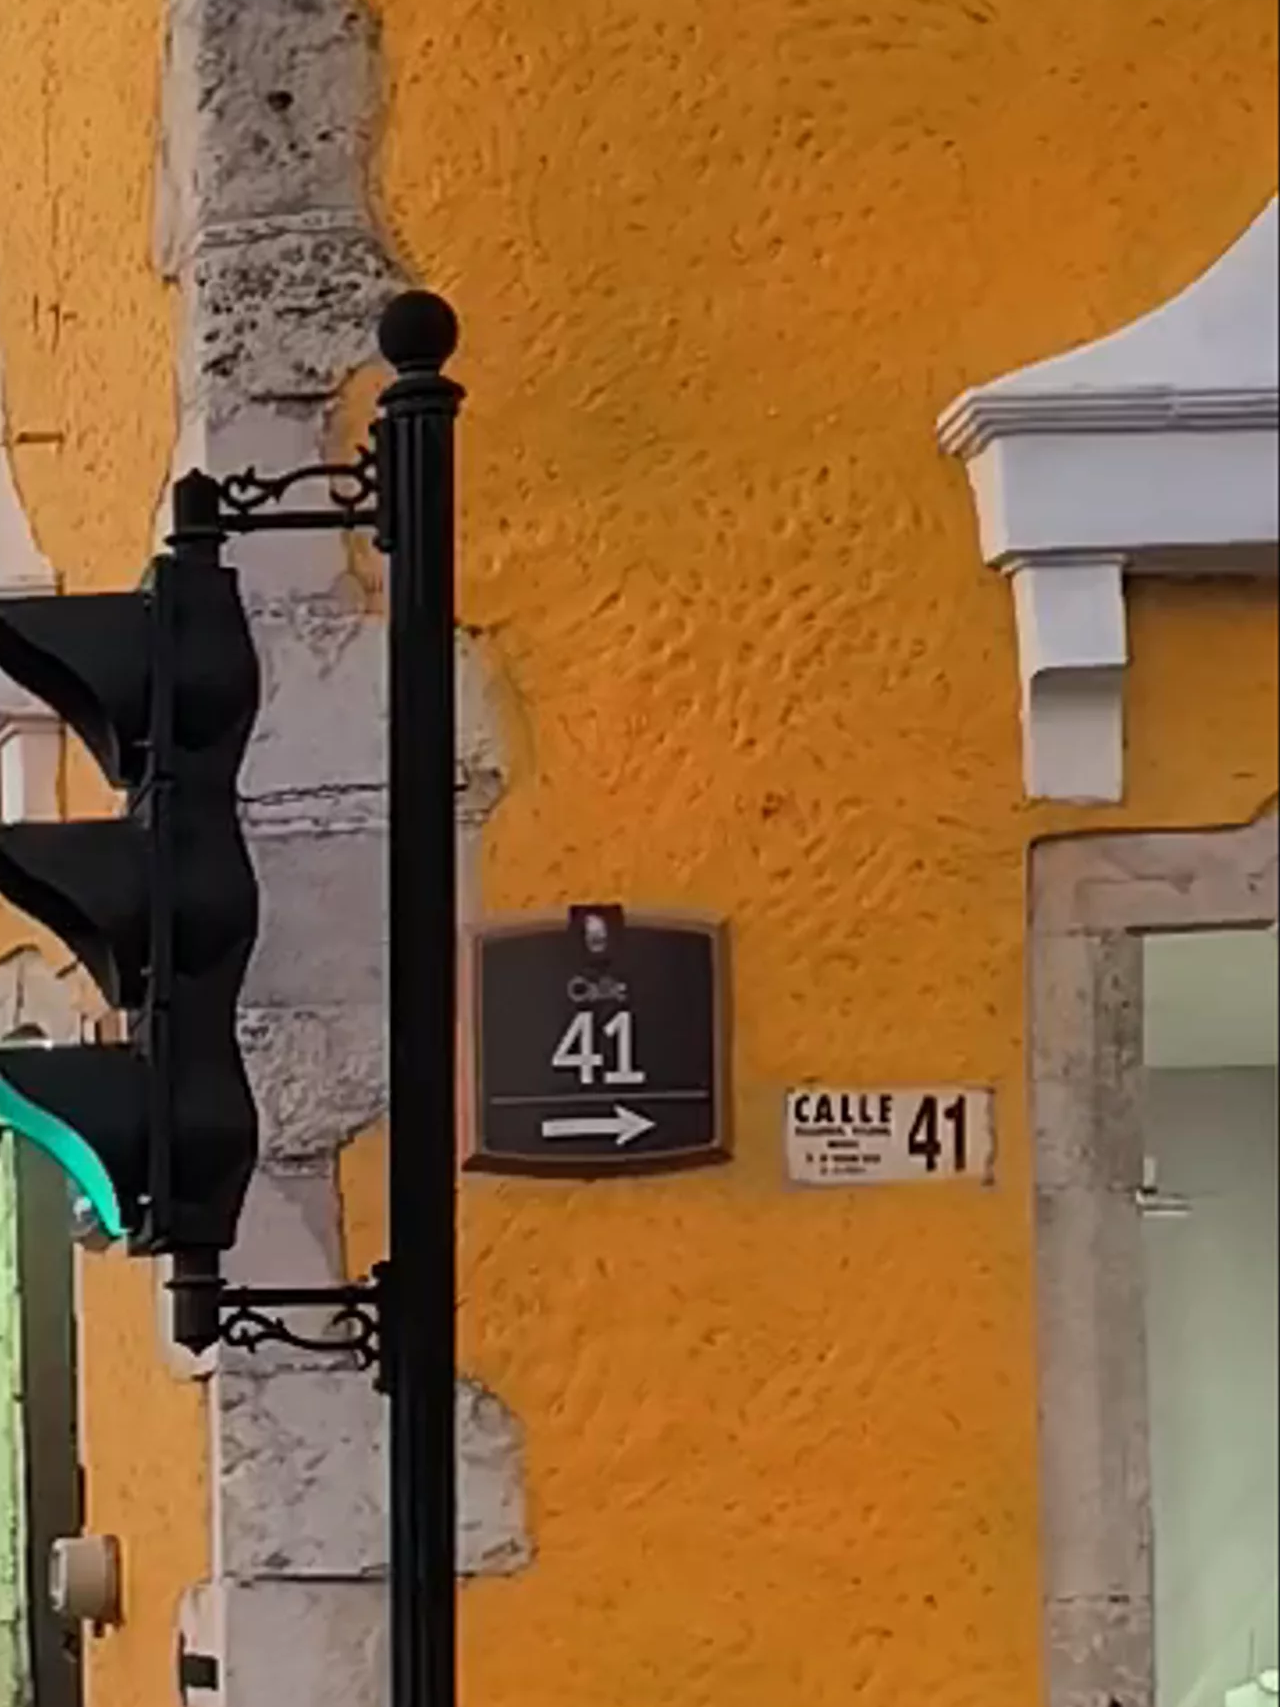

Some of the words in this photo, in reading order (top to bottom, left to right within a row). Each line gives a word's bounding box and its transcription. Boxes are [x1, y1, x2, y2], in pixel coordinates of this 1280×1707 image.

[552, 1010, 646, 1084] 41
[795, 1094, 894, 1123] CALLE
[908, 1094, 966, 1173] 41
